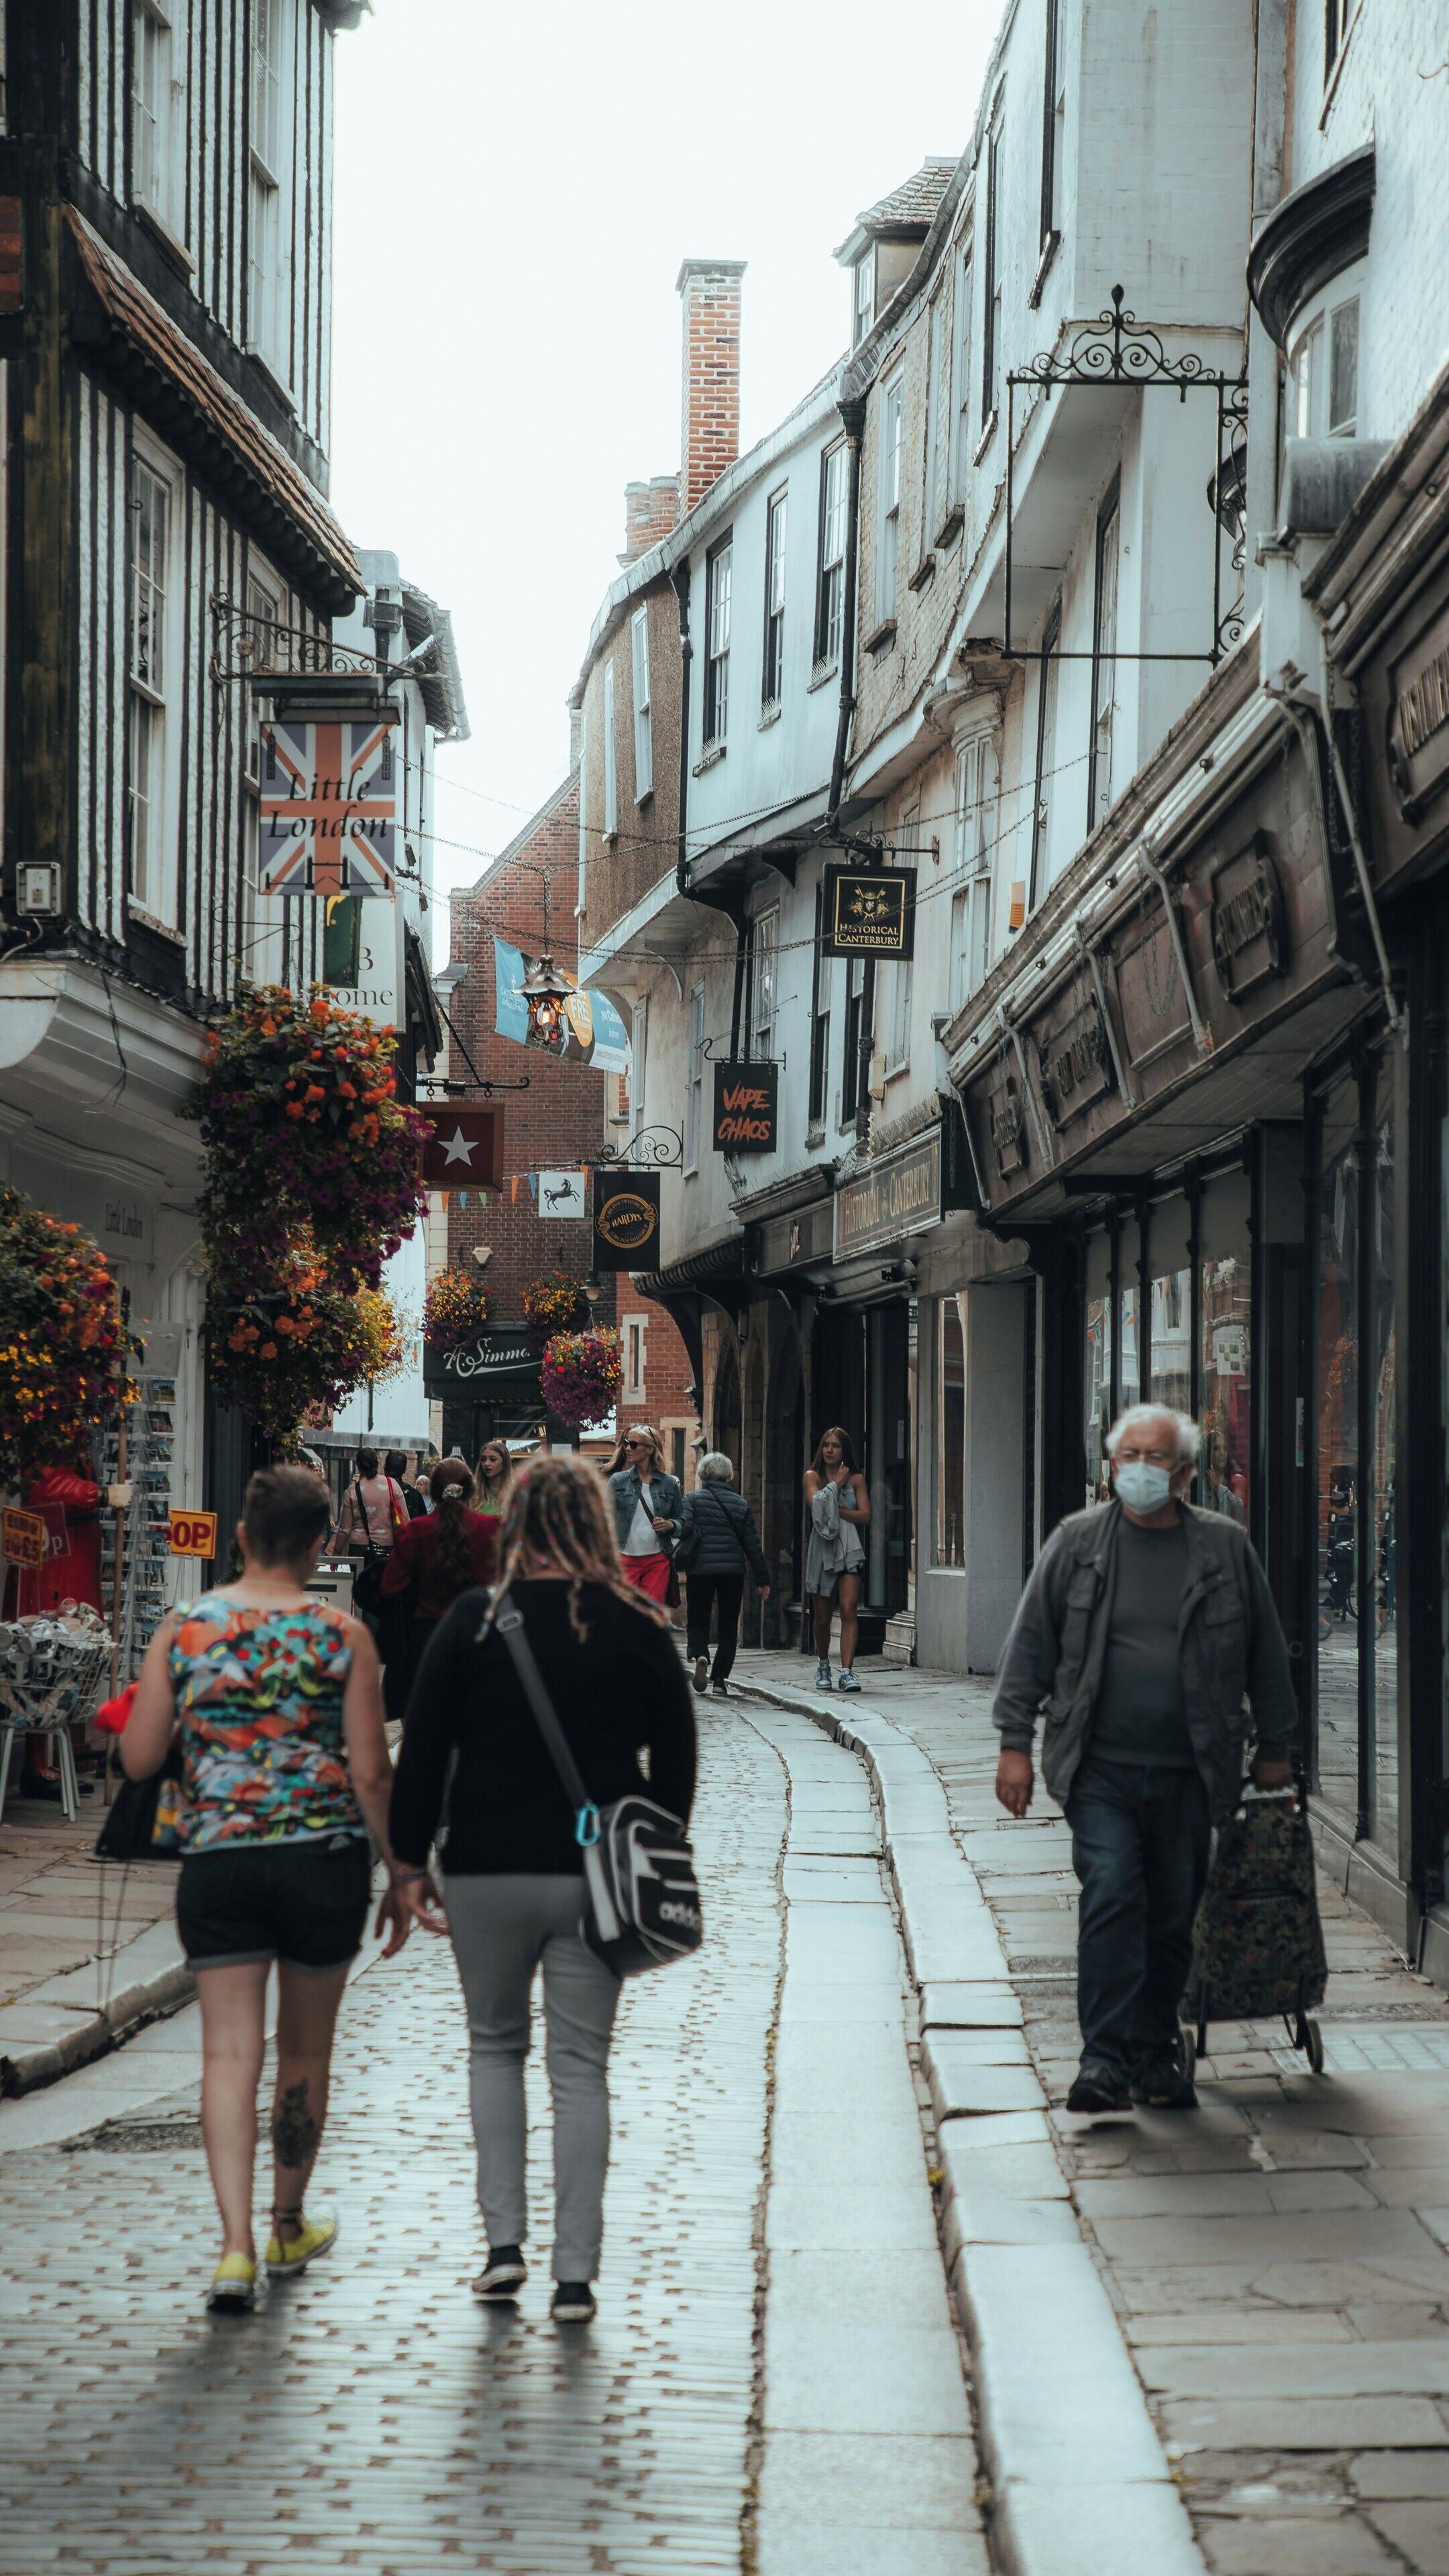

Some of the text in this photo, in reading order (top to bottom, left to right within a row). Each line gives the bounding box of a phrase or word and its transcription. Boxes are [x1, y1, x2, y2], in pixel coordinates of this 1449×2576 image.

[286, 767, 370, 801] Little
[267, 804, 387, 838] London
[838, 933, 899, 945] CANTERBURY
[839, 923, 899, 935] HISTORICAL
[329, 989, 393, 1006] ome
[722, 1080, 771, 1112] VAPE
[718, 1116, 771, 1142] CHAOS
[845, 1161, 931, 1235] HISTORICAL CANTERBURY
[611, 1213, 643, 1228] HARDYS
